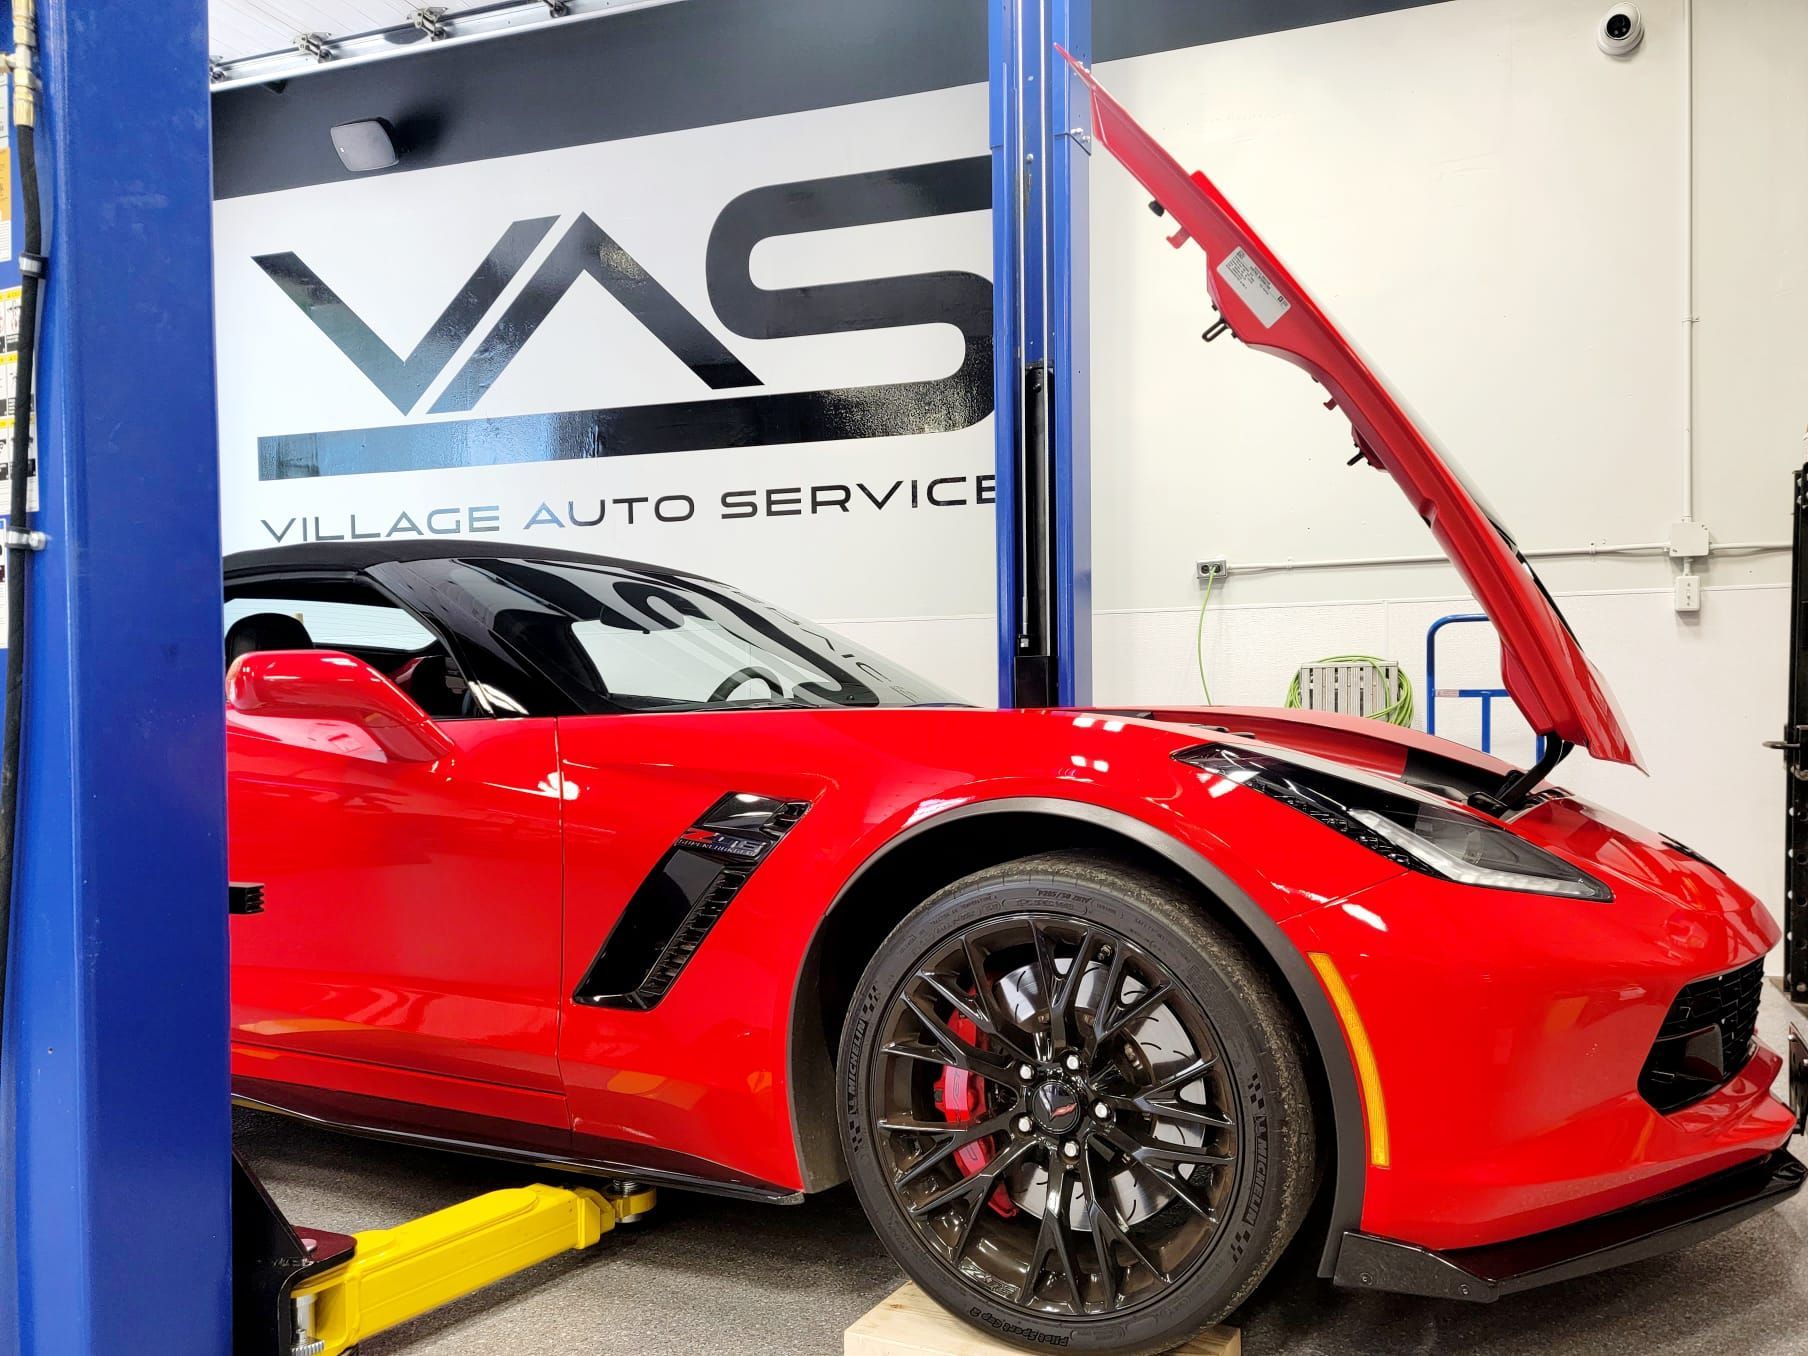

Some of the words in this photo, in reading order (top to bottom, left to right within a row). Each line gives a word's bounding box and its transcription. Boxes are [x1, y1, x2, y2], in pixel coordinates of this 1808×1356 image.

[250, 155, 996, 480] VAS
[260, 504, 501, 543] VILLAGE
[523, 494, 695, 530] AUTO
[720, 474, 996, 520] SERVICE
[847, 1019, 868, 1093] MICHELIN
[1243, 1136, 1269, 1226] MICHELIN
[969, 1306, 982, 1318] 2
[1002, 1322, 1039, 1342] Sport
[1038, 1334, 1070, 1348] Pilot
